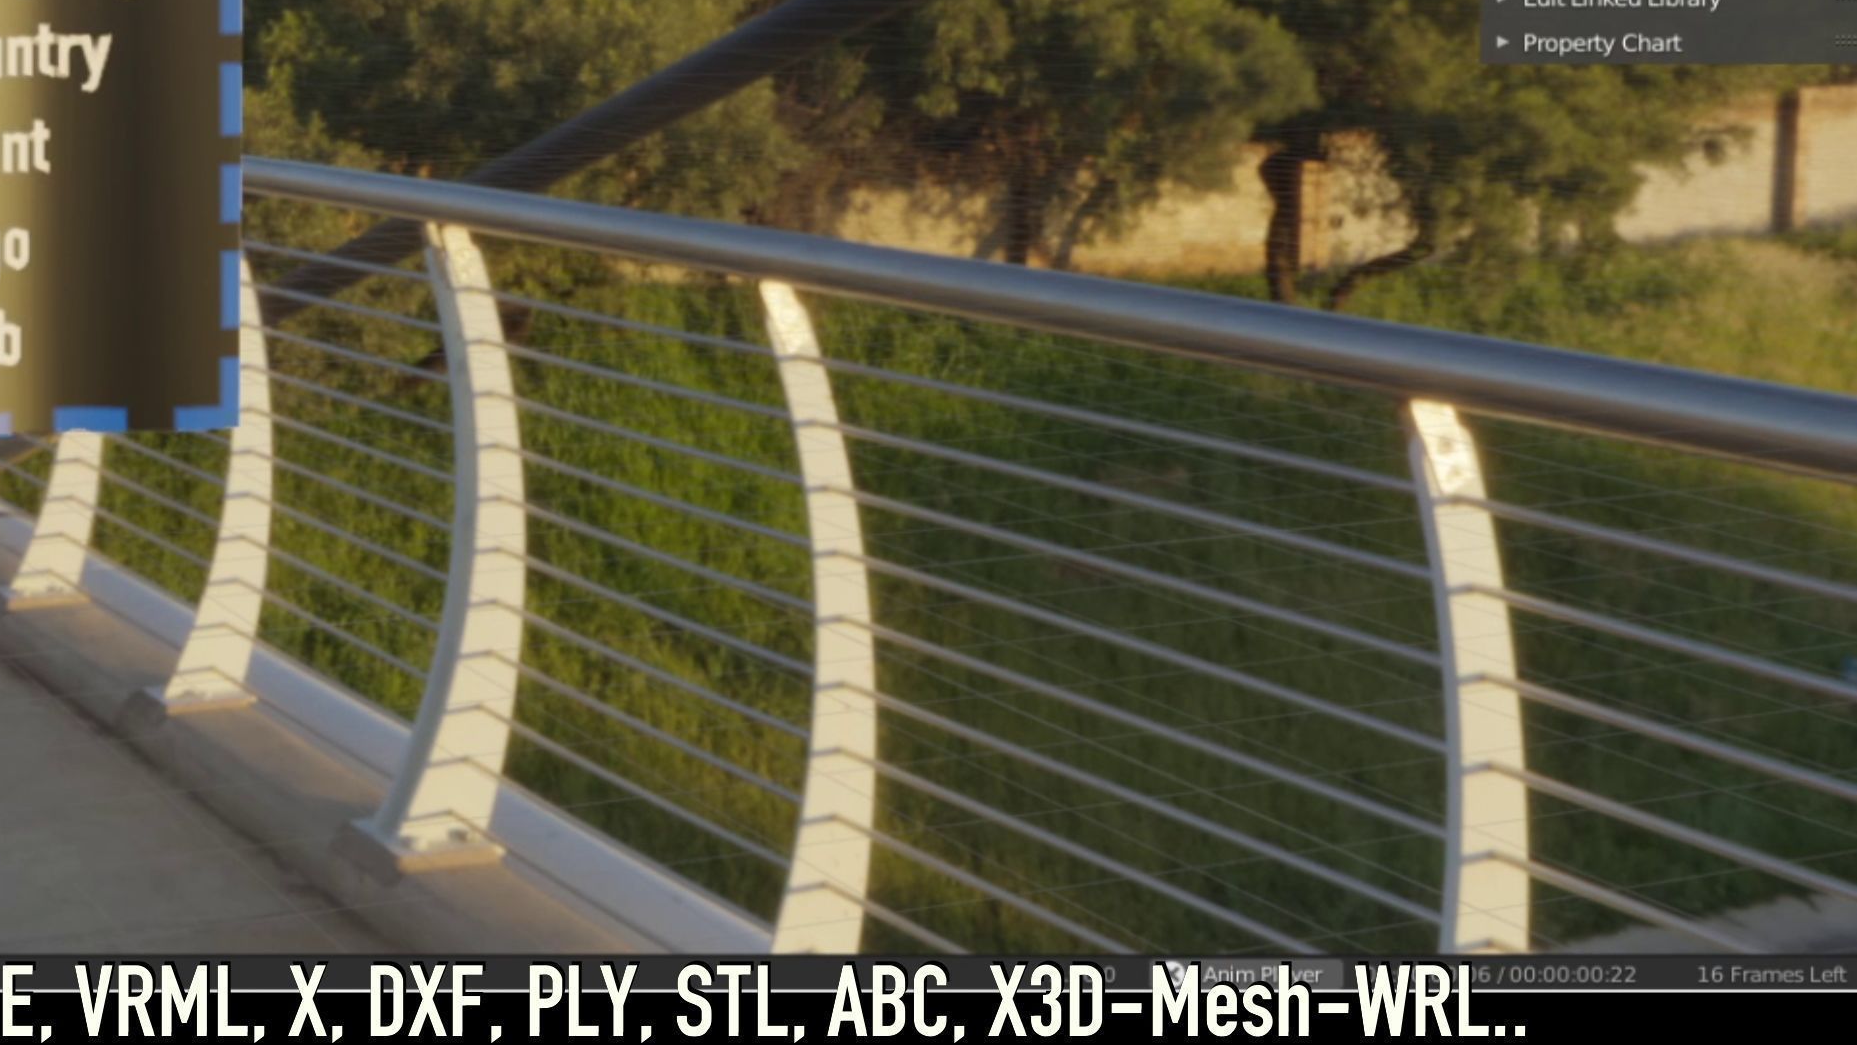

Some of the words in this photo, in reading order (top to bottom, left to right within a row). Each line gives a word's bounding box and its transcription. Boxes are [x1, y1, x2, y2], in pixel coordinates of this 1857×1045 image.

[1523, 34, 1615, 56] Property
[1622, 34, 1683, 52] Chart
[1203, 966, 1255, 983] Anim
[1509, 965, 1637, 983] 00:00:00:22
[1698, 966, 1724, 983] 16
[1731, 966, 1804, 983] Frames
[1810, 965, 1848, 983] Left
